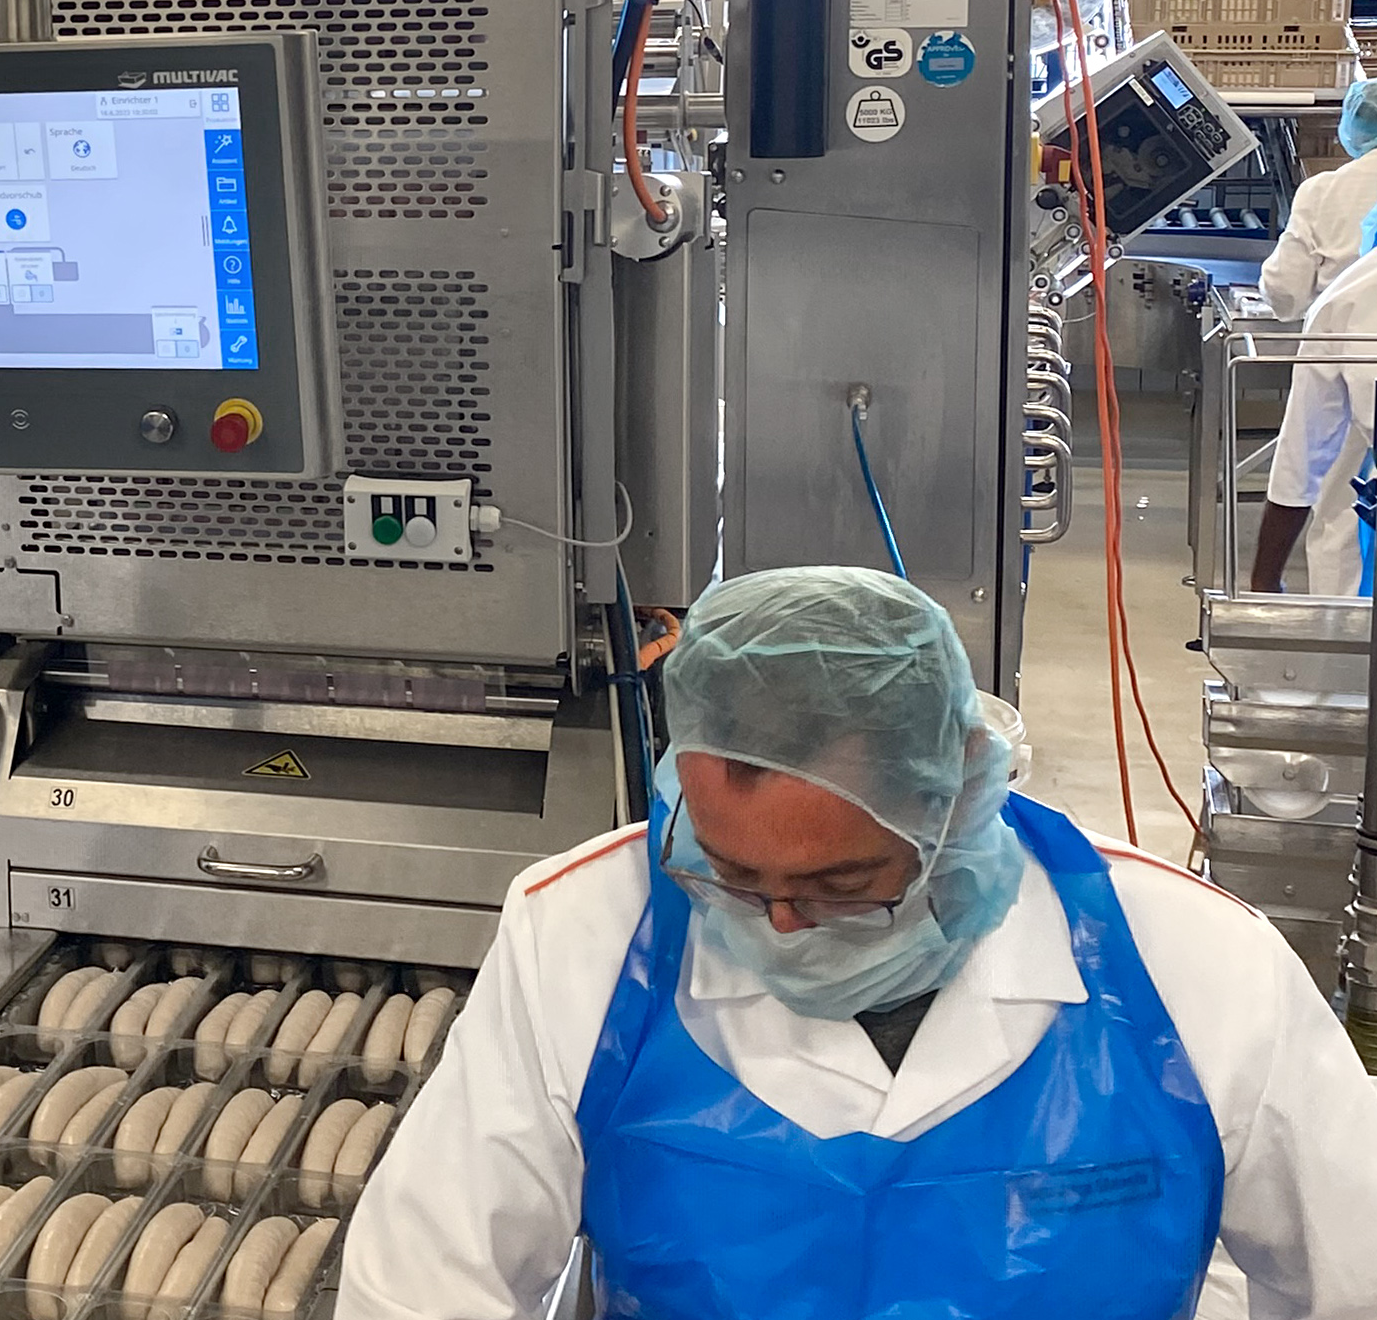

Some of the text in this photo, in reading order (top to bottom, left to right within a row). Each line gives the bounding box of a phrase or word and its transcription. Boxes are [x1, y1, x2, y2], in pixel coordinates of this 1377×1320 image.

[866, 40, 904, 70] GS
[152, 69, 239, 85] MULTIVAC
[111, 96, 159, 105] Einrichter 1
[49, 127, 83, 137] Sprache
[50, 788, 74, 807] 30
[50, 888, 72, 908] 31
